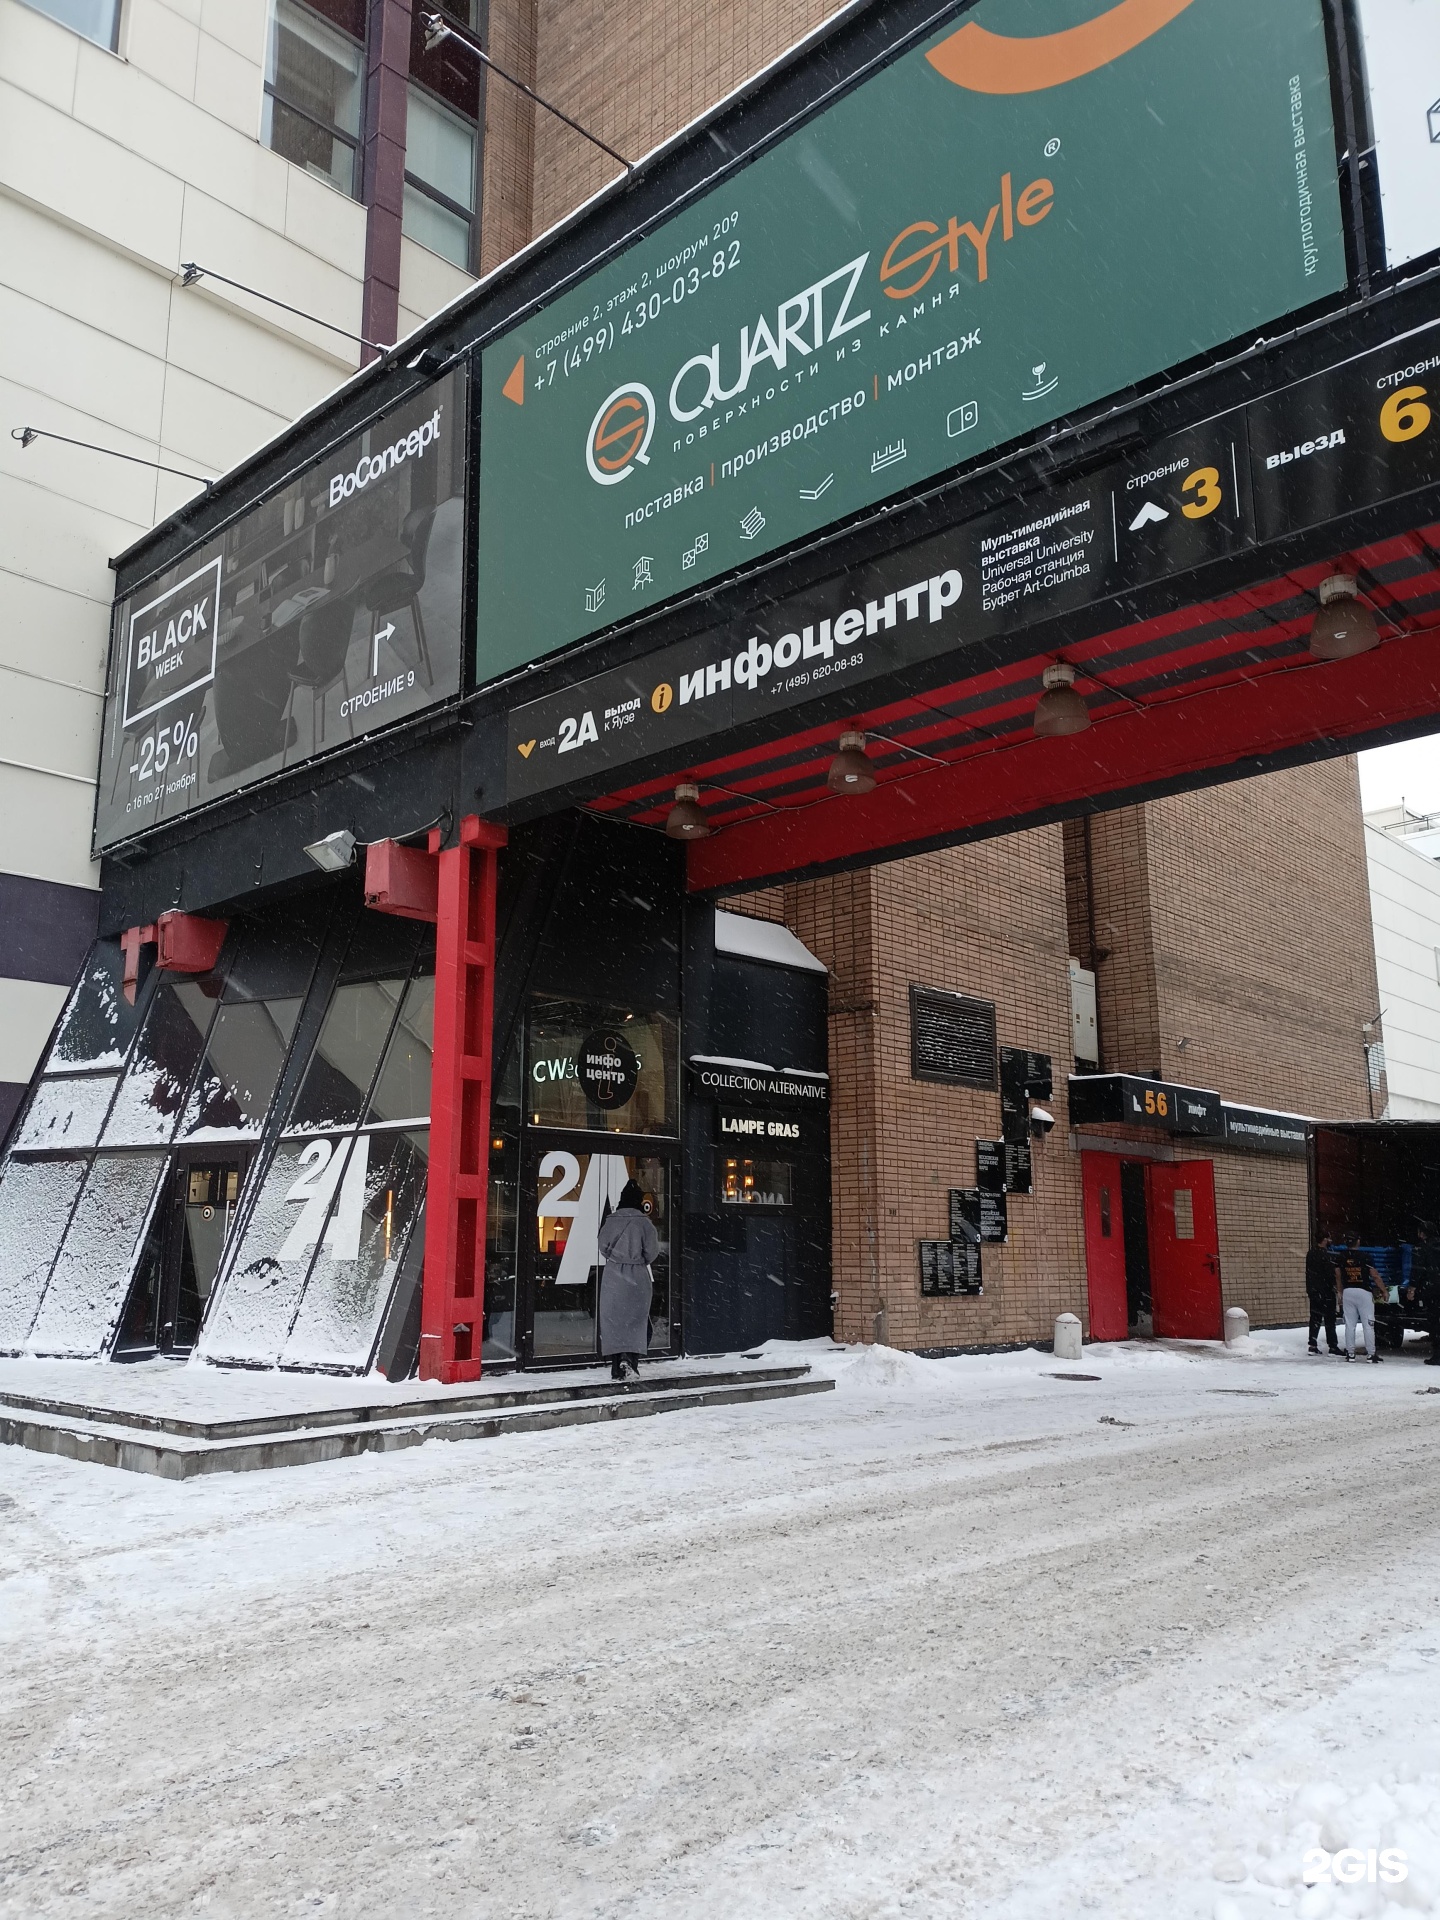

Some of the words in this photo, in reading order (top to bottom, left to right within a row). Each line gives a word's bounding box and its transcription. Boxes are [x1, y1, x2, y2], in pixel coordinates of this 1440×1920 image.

[1289, 74, 1306, 148] выставка
[1295, 149, 1318, 277] круглогодичная
[535, 315, 589, 360] строение
[592, 304, 603, 321] 2,
[606, 282, 638, 312] этаж
[641, 271, 652, 289] 2,
[655, 233, 708, 279] шоурум
[713, 211, 739, 241] 209
[668, 251, 871, 422] QUARTZ
[880, 171, 1055, 300] Style
[534, 360, 557, 391] +7
[563, 322, 614, 377] (499)
[621, 240, 741, 336] 430-03-82
[879, 283, 960, 339] КАМНЯ
[624, 473, 704, 529] поставка
[720, 389, 866, 479] производство
[887, 326, 982, 392] монтаж
[1379, 385, 1431, 443] 6
[329, 408, 441, 508] BoConcept
[1266, 428, 1346, 470] выезд
[1126, 456, 1190, 491] строение
[1181, 466, 1222, 519] 3
[981, 499, 1091, 553] Мультимедийная
[981, 535, 1041, 567] выставка
[982, 552, 1034, 581] Universal
[1036, 529, 1095, 561] University
[982, 571, 1032, 596] Рабочая
[1034, 549, 1085, 577] станция
[982, 590, 1020, 612] Буфет
[1023, 562, 1091, 596] Art-Clumba
[137, 596, 208, 670] BLACK
[678, 568, 964, 706] инфоцентр
[155, 650, 184, 680] WEEK
[770, 682, 783, 695] +7
[785, 672, 810, 692] (495)
[812, 653, 864, 680] 620-08-83
[340, 674, 404, 718] СТРОЕНИЕ
[407, 670, 415, 687] 9
[604, 697, 641, 719] выход
[539, 736, 556, 749] вход
[557, 710, 599, 755] 2А
[604, 721, 610, 732] к
[612, 712, 635, 730] Яузе
[129, 712, 198, 782] -25%
[133, 795, 142, 810] 16
[143, 792, 153, 806] по
[154, 784, 165, 800] 27
[166, 772, 196, 795] ноября
[586, 1054, 622, 1068] инфо
[586, 1067, 626, 1084] центр
[701, 1071, 766, 1092] COLLECTION
[768, 1080, 826, 1099] ALTERNATIVE
[1145, 1089, 1168, 1117] 56
[721, 1117, 765, 1135] LAMPE
[767, 1121, 800, 1138] GRAS
[1187, 1104, 1206, 1118] лифт
[1002, 1183, 1007, 1192] 5
[1028, 1185, 1033, 1194] 6
[976, 1233, 981, 1243] 3
[978, 1286, 984, 1296] 2
